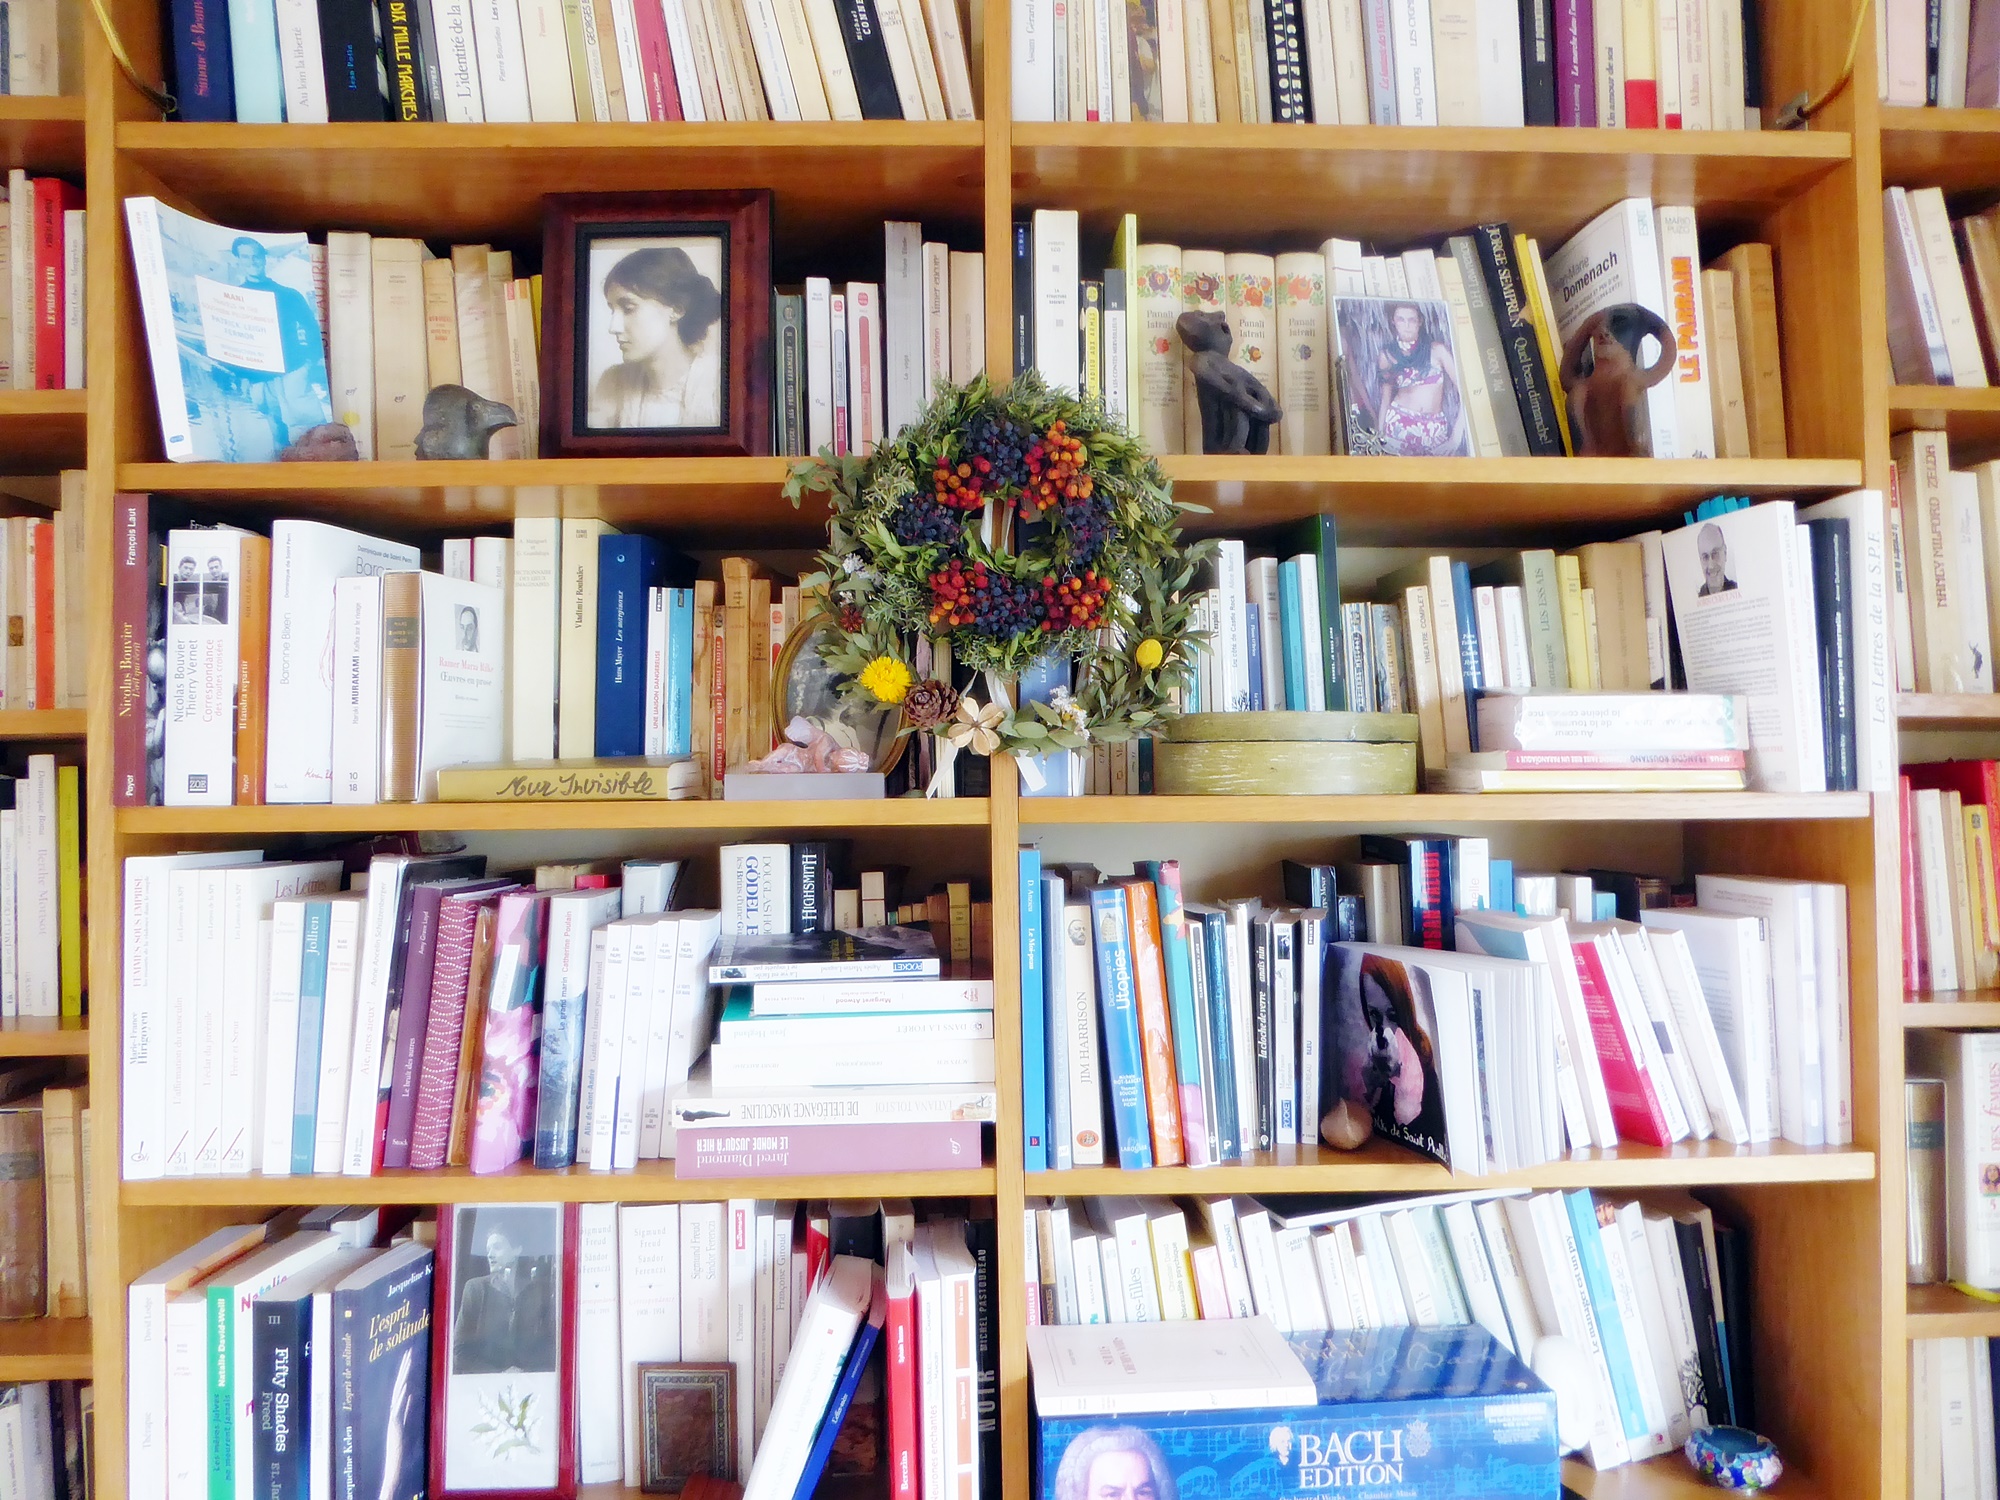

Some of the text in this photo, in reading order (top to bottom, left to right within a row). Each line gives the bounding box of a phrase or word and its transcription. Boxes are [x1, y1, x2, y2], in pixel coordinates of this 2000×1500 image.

[447, 4, 471, 96] L'identité de la
[582, 4, 596, 44] GEORGES
[290, 26, 310, 108] Au loin la liberté
[390, 2, 417, 119] DIX MILLE MARCHES
[1272, 0, 1291, 117] LLIAM BOYD
[1604, 46, 1615, 126] Un amour de soi
[930, 255, 941, 317] Aimer encore
[1563, 252, 1618, 303] Domenach
[1486, 226, 1553, 444] JORGE SEMPRUN Quel beau dimanche!
[1670, 257, 1700, 382] LE PARRAIN
[126, 508, 138, 566] François Laut
[1924, 445, 1948, 608] NANCY MILFORD ZELDA
[280, 613, 291, 685] Baronne Blixen
[1418, 595, 1431, 664] THEATRE COMPLET
[1534, 568, 1557, 688] ontaigne LES ESSAIS
[1867, 531, 1885, 723] Les Lettres de la S.P.F.
[119, 622, 133, 717] Nicolas Bouvier
[173, 639, 185, 723] Nicolas Bouvier
[186, 639, 199, 717] Thierry Vernet
[203, 639, 216, 723] Correspondance
[214, 639, 224, 717] des routes croisées
[241, 660, 250, 692] repartir
[351, 656, 359, 705] MURAKAMI
[440, 672, 493, 688] Œuvres en prose
[653, 650, 662, 690] DANGEREUSE
[240, 694, 249, 723] faudra
[652, 691, 661, 715] LIAISON
[125, 774, 136, 796] Payot
[242, 774, 250, 793] Payot
[349, 772, 359, 781] 10
[349, 784, 358, 793] 18
[558, 771, 657, 797] Invisible
[745, 856, 760, 919] GÖDEL
[802, 854, 817, 919] HIGHSMITH
[1421, 852, 1441, 905] FALUDI
[307, 916, 320, 956] Jollien
[557, 911, 574, 1031] Le grand marin Catherine Poulain
[893, 962, 923, 971] POCKET
[1103, 950, 1116, 1007] Dictionnaire des
[1112, 948, 1131, 1010] Utopies
[862, 995, 891, 1004] Margaret
[1256, 946, 1267, 1058] la cloche de verre anaïs nin
[138, 1011, 151, 1064] Hirigoyen
[1076, 991, 1092, 1084] JIM HARRISON
[401, 1038, 415, 1097] Le bruit des autres
[584, 1068, 597, 1137] Alix de Saint-André
[740, 1101, 860, 1119] DE L'ÉLÉGANCE MASCULINE
[1281, 1100, 1291, 1129] POCKET
[696, 1136, 789, 1153] LE MONDE JUSQU'À HIER
[697, 1151, 790, 1168] Jared Diamond
[775, 1233, 786, 1312] Françoise Giroud
[1171, 1242, 1188, 1319] bisexualité psychique
[1565, 1234, 1600, 1355] Le manager est un psy
[216, 1298, 226, 1387] Natalie David-Weill
[268, 1315, 281, 1324] III
[369, 1299, 410, 1339] L'esprit
[980, 1316, 988, 1351] MICHEL
[370, 1338, 384, 1363] de
[261, 1391, 273, 1430] Freed
[272, 1347, 289, 1452] Fifty Shades
[341, 1333, 354, 1500] acqueline Kelen L'esprit de solitude
[977, 1370, 996, 1432] NOIR
[900, 1451, 909, 1491] Berezina
[1298, 1428, 1404, 1467] BACH
[1299, 1463, 1403, 1489] EDITION
